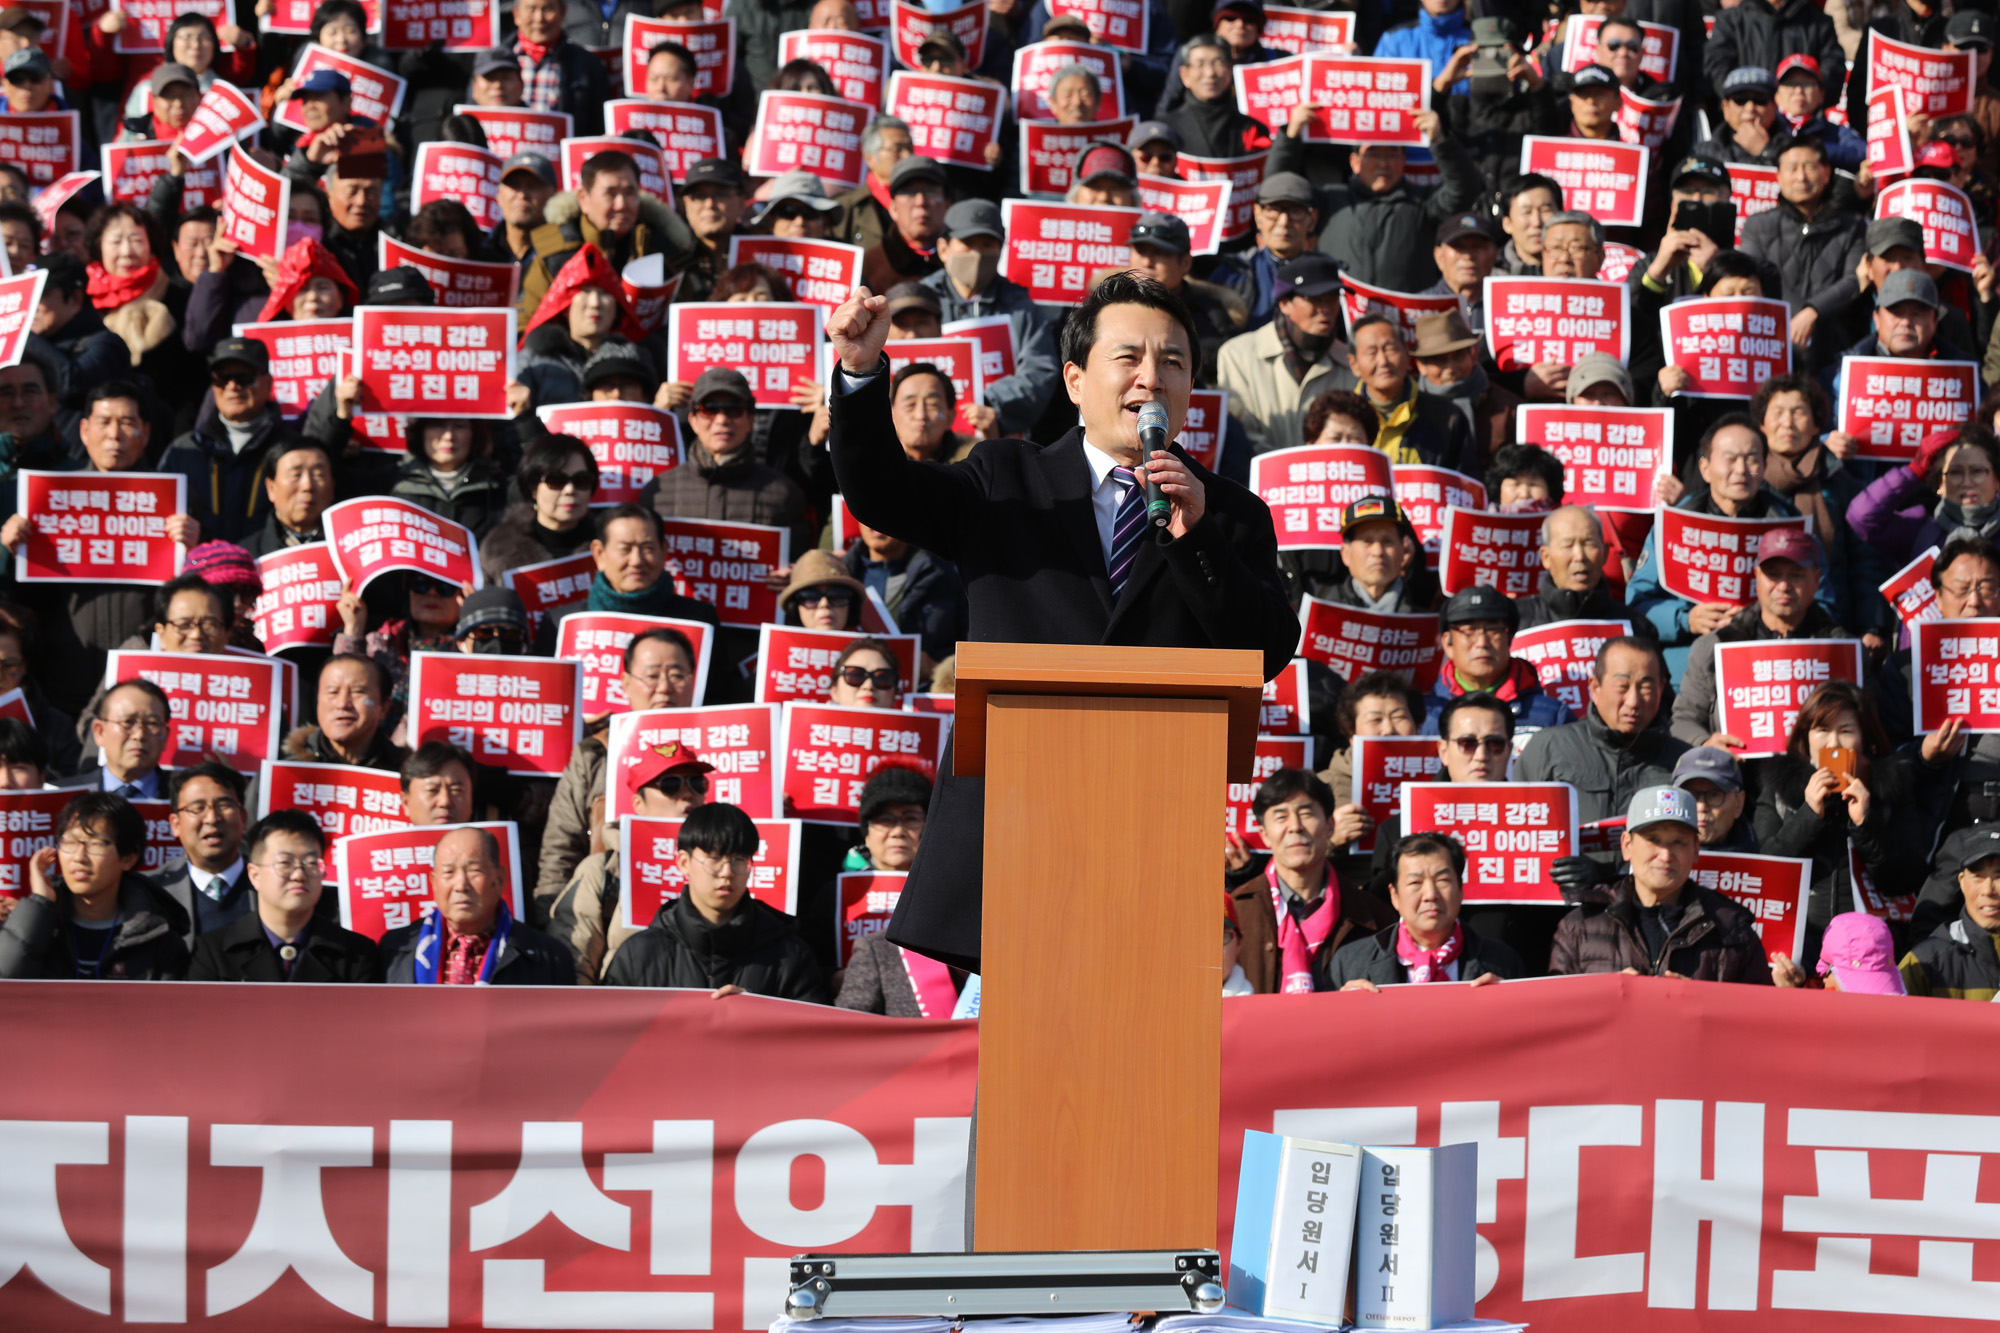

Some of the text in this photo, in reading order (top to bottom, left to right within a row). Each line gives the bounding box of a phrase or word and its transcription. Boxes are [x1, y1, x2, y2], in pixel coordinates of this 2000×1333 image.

[1507, 294, 1604, 316] 전투력 강한
[697, 320, 797, 340] 전투력 강한
[1688, 313, 1776, 335] 전투력 강한
[383, 325, 488, 347] 전투력 강한
[1866, 374, 1961, 398] 전투력 강한
[624, 419, 661, 441] 강한
[1545, 422, 1645, 445] 전투력 강한
[1288, 461, 1365, 482] 행동하는
[49, 490, 157, 512] 전투력 강한
[1472, 526, 1529, 546] 전투력
[1682, 526, 1738, 552] 전투력
[722, 540, 760, 559] 강한
[1941, 637, 1998, 658] 전투력
[1752, 659, 1828, 682] 행동하는
[208, 675, 251, 698] 강한
[457, 673, 540, 698] 행동하는
[708, 725, 749, 747] 강한
[810, 724, 920, 753] 전투력 강한
[294, 784, 357, 809] 전투력
[1434, 803, 1549, 825] 전투력 강한
[1644, 807, 1691, 819] SEOUL
[1297, 1161, 1331, 1274] 입당원서
[1378, 1164, 1401, 1276] 입당원서
